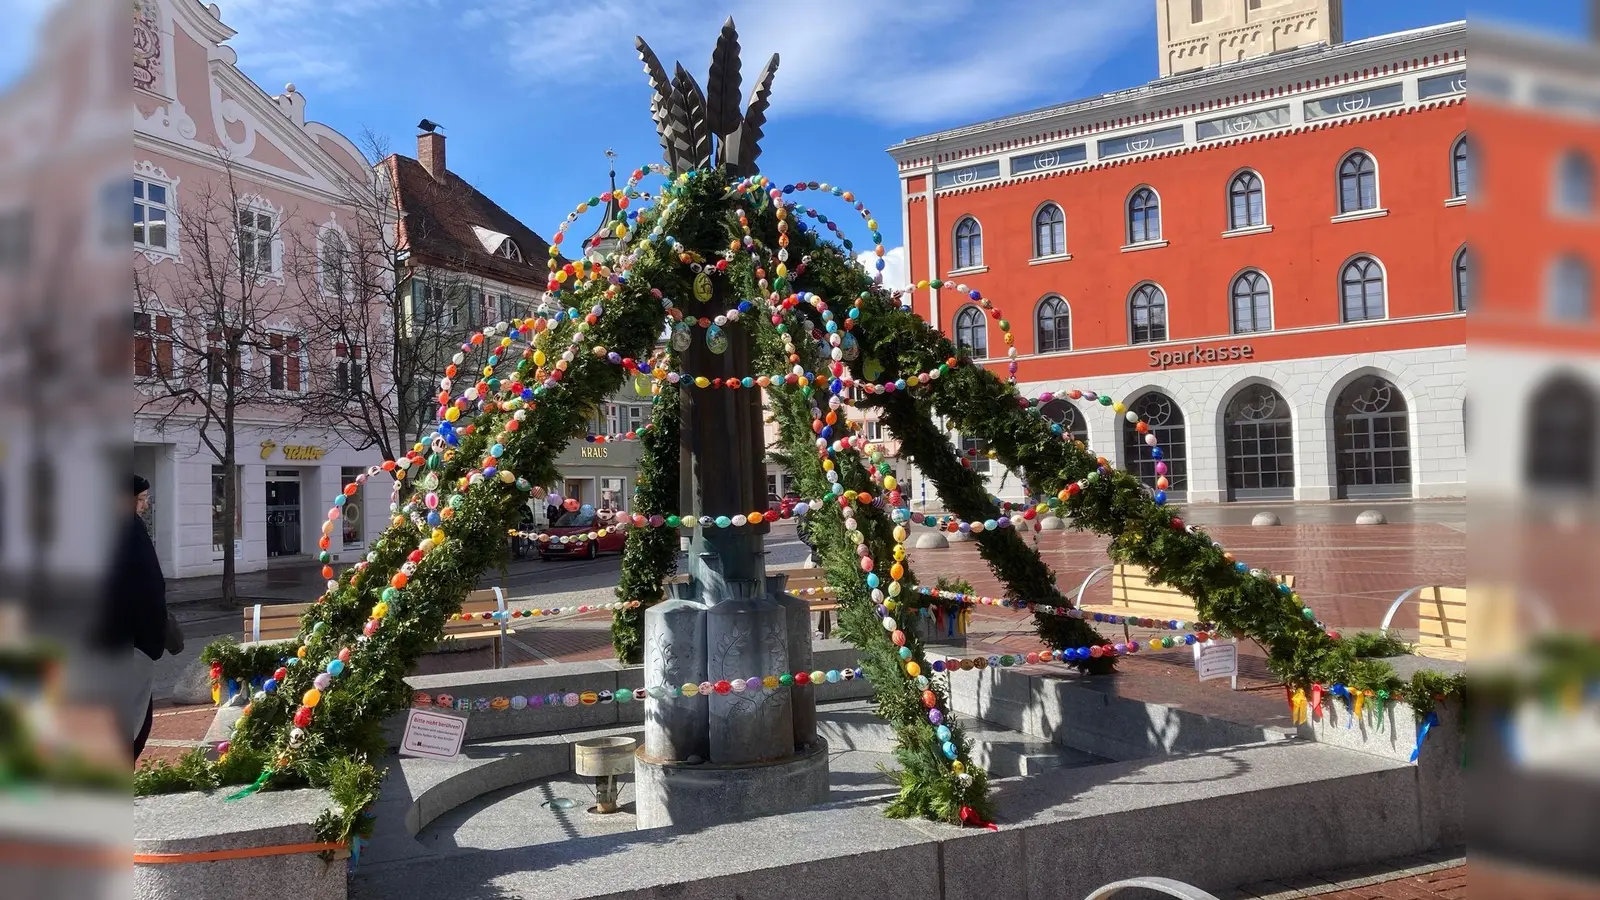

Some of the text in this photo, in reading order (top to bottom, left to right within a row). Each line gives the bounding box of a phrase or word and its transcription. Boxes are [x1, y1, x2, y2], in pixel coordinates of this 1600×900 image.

[1148, 344, 1254, 370] Sparkasse
[283, 445, 326, 460] Tchibo
[581, 446, 608, 458] KRAUS
